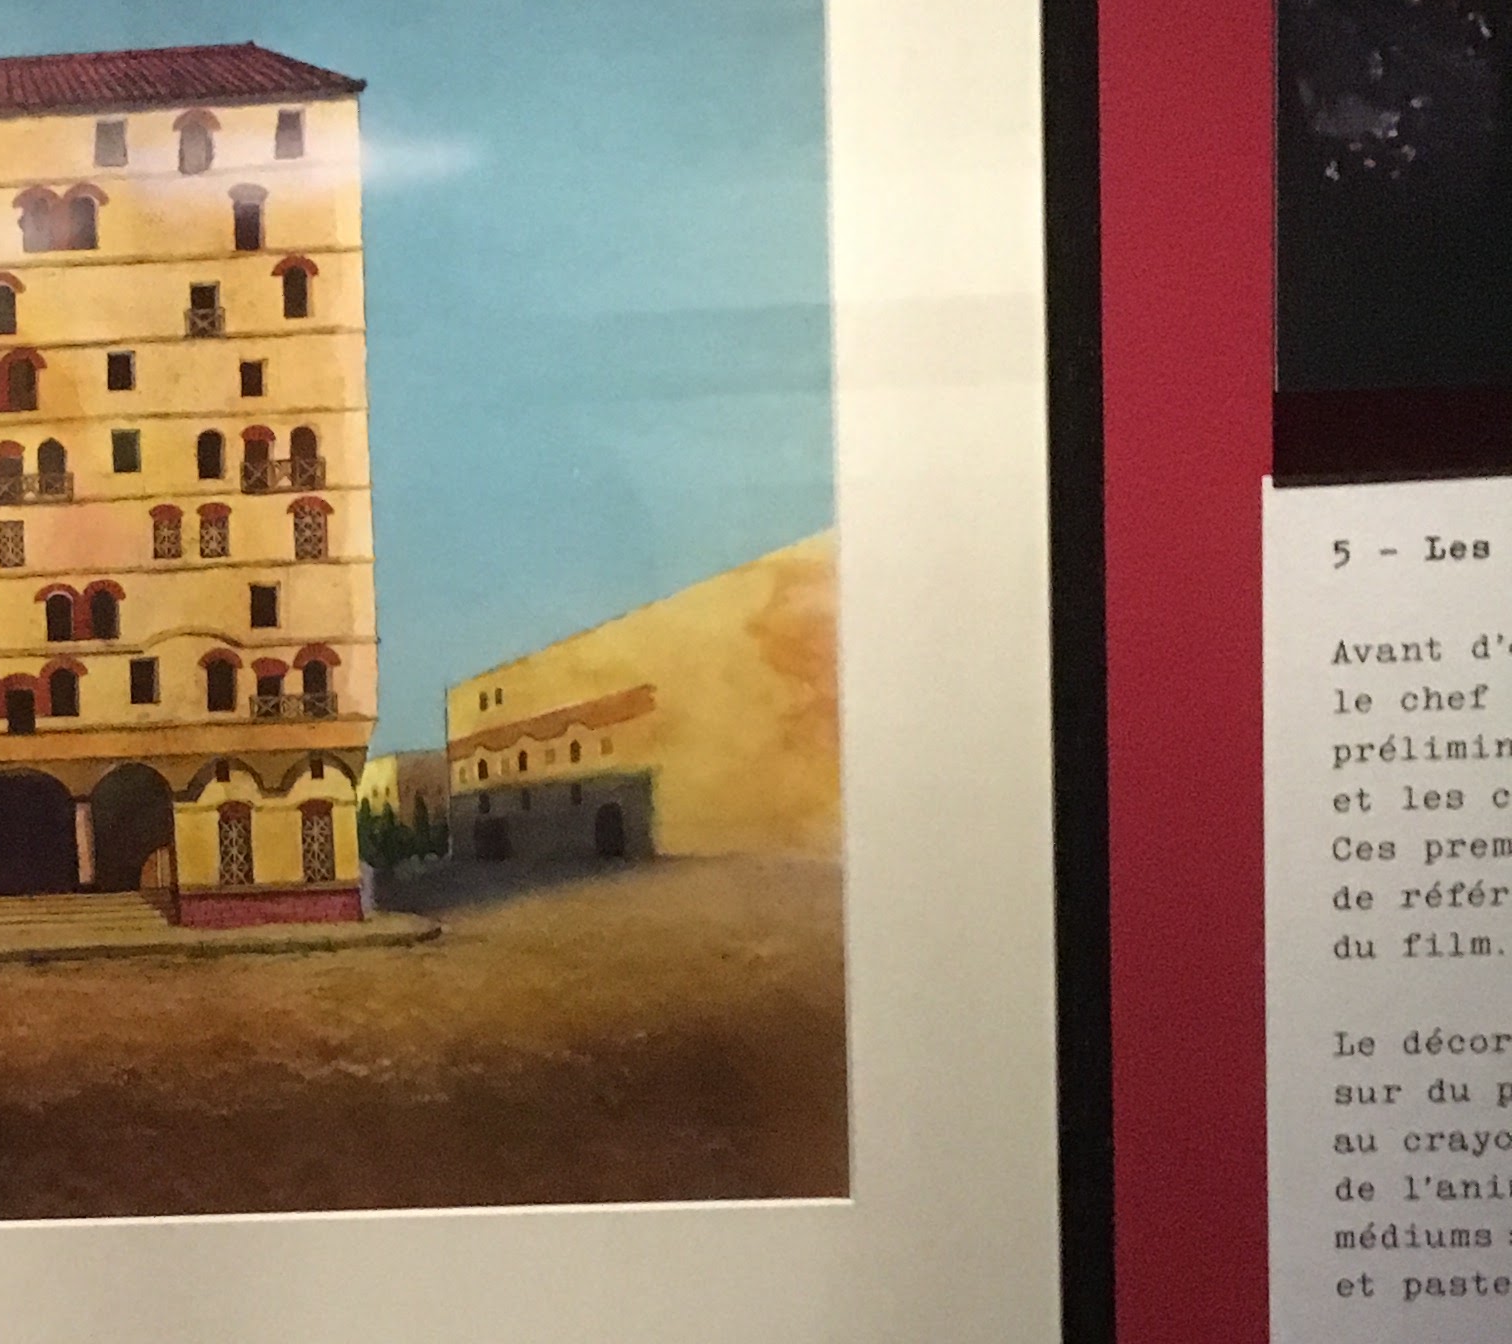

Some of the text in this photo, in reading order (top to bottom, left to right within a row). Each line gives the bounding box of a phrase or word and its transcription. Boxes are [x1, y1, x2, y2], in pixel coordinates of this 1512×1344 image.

[1332, 539, 1351, 570] 5
[1424, 535, 1491, 562] Les
[1331, 633, 1512, 666] Avant d'
[1334, 683, 1489, 715] le chef
[1332, 733, 1512, 770] prélimin
[1332, 787, 1372, 814] et
[1403, 785, 1464, 811] les
[1331, 836, 1512, 866] Ces prem
[1332, 879, 1510, 912] de référ
[1332, 931, 1505, 960] du film.
[1333, 1026, 1512, 1058] Le décor
[1334, 1084, 1403, 1106] sur
[1427, 1078, 1471, 1104] du
[1332, 1130, 1512, 1158] au crayo
[1334, 1174, 1512, 1202] de l'ani
[1334, 1221, 1493, 1251] médiums
[1335, 1272, 1512, 1303] et paste
